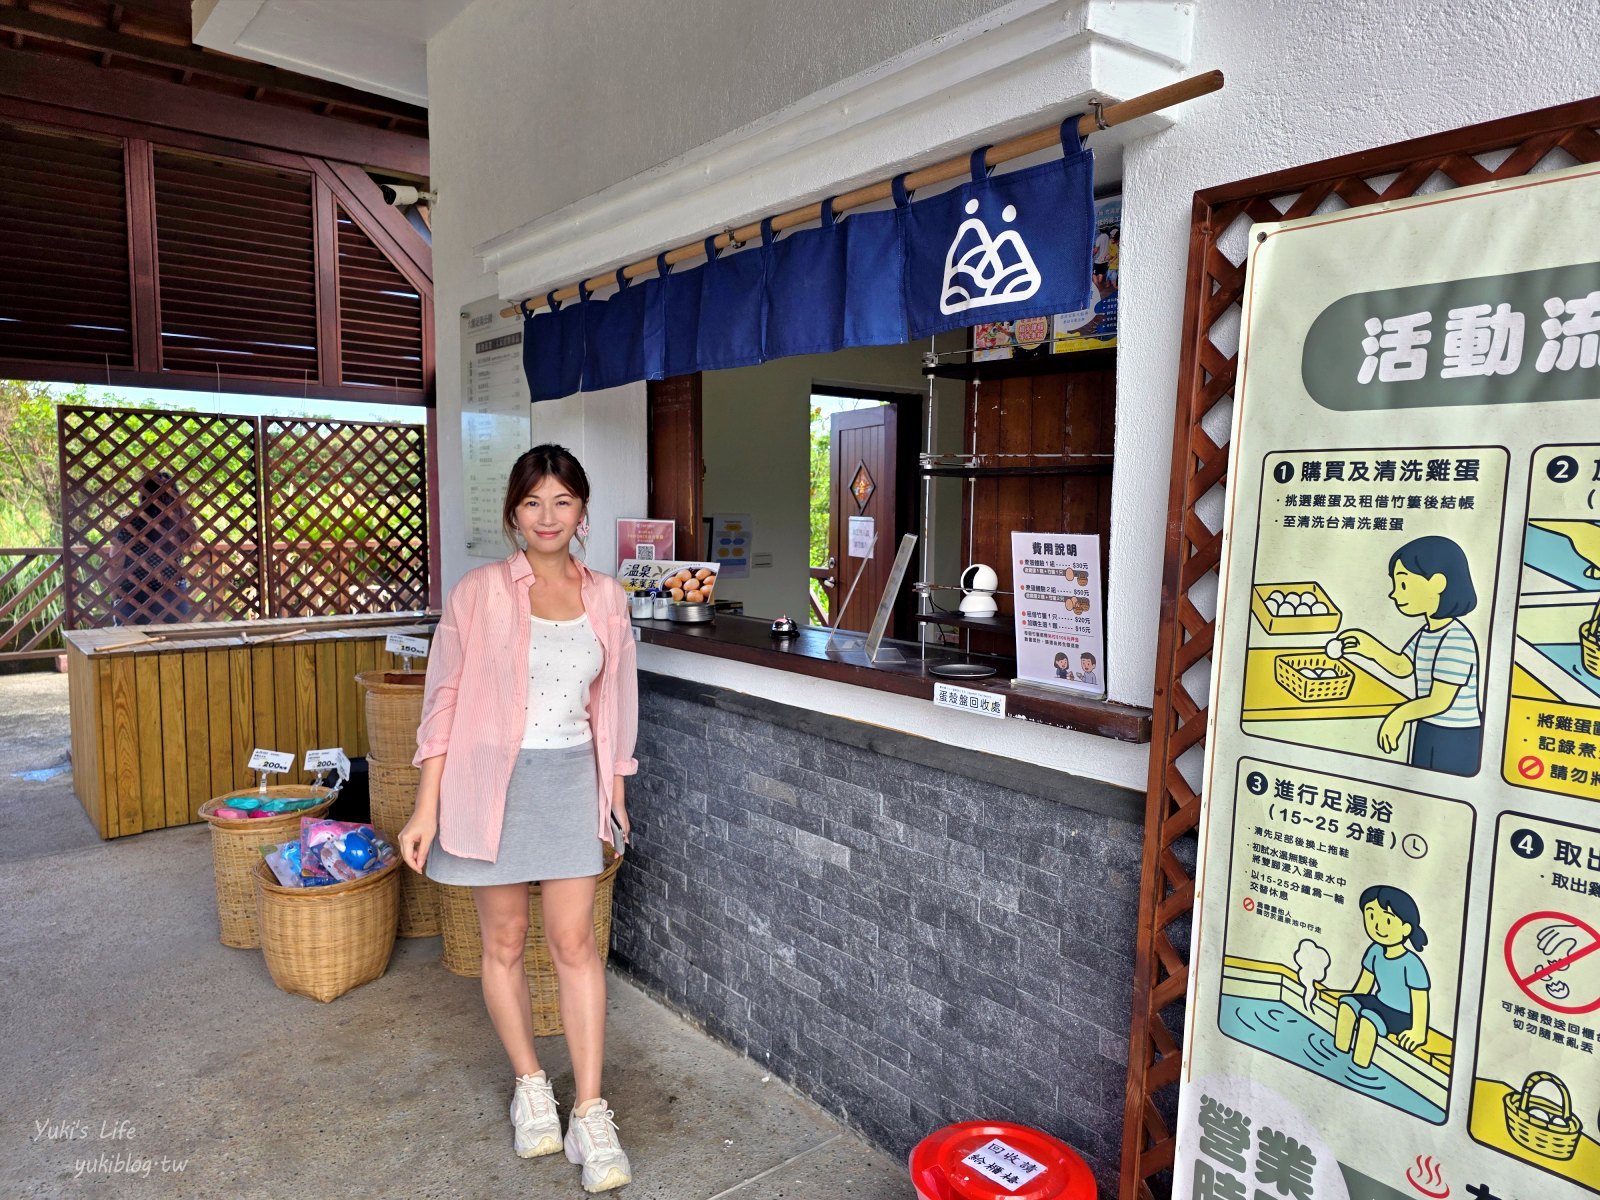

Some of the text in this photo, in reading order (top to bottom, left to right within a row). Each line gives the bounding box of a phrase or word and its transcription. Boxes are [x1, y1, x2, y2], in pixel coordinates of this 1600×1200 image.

[1357, 290, 1600, 384] 活動流
[1301, 459, 1480, 482] 購買及清洗雞蛋
[1284, 493, 1475, 511] 挑選雞蛋及租借竹簍後結帳
[1283, 515, 1404, 531] 至清洗台清洗雞蛋
[1032, 541, 1078, 557] 費用說明
[938, 690, 1001, 713] 蛋殼盤回收處
[1538, 736, 1600, 759] 記錄煮
[1273, 777, 1393, 824] 進行足湯浴
[1249, 881, 1289, 901] 交替休息
[1512, 1017, 1594, 1055] 切勿隨意亂丟
[1198, 1093, 1317, 1200] 營業
[987, 1143, 1038, 1174] 回收請
